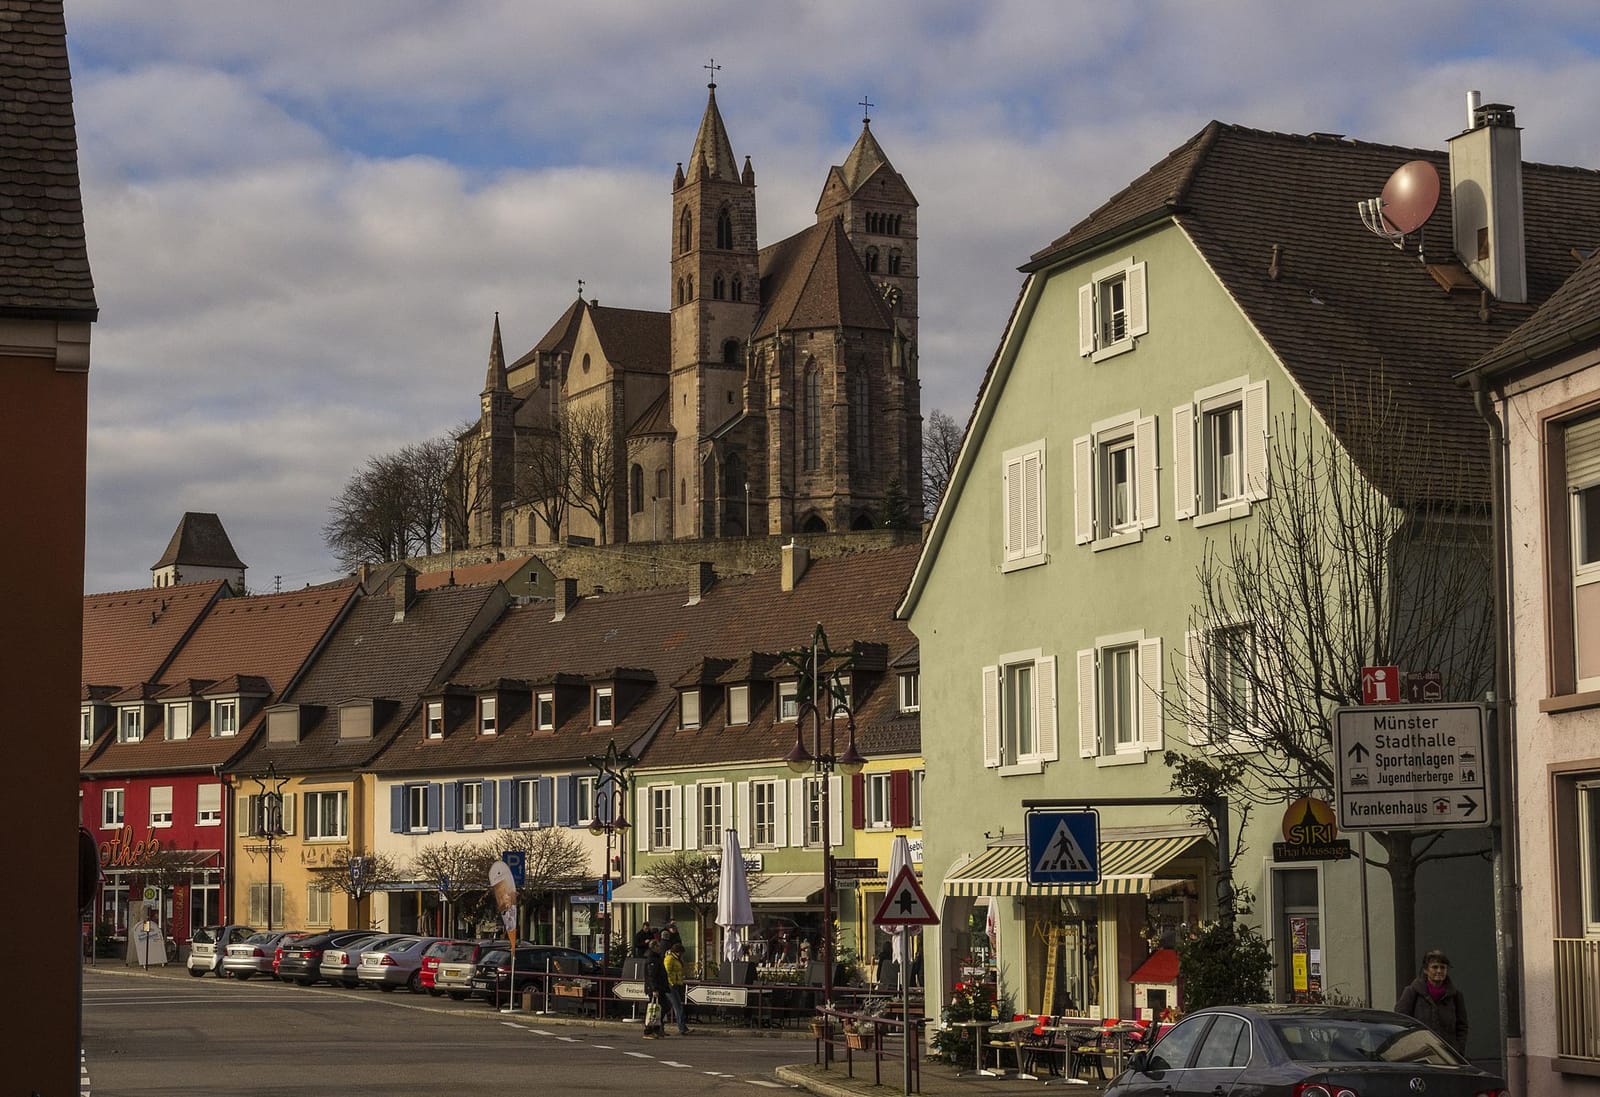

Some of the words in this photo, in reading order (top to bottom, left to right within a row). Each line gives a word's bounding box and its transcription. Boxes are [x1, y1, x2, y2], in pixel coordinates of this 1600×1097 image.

[1374, 715, 1439, 731] Münster
[1375, 733, 1456, 750] Stadthalle
[1375, 752, 1454, 770] Sportanlagen
[1377, 771, 1453, 786] Jugendherberge
[1350, 801, 1428, 817] Krankenhaus
[1289, 824, 1332, 845] SIRI
[1275, 844, 1300, 857] Thai
[1302, 844, 1348, 858] Massage
[507, 855, 520, 866] P
